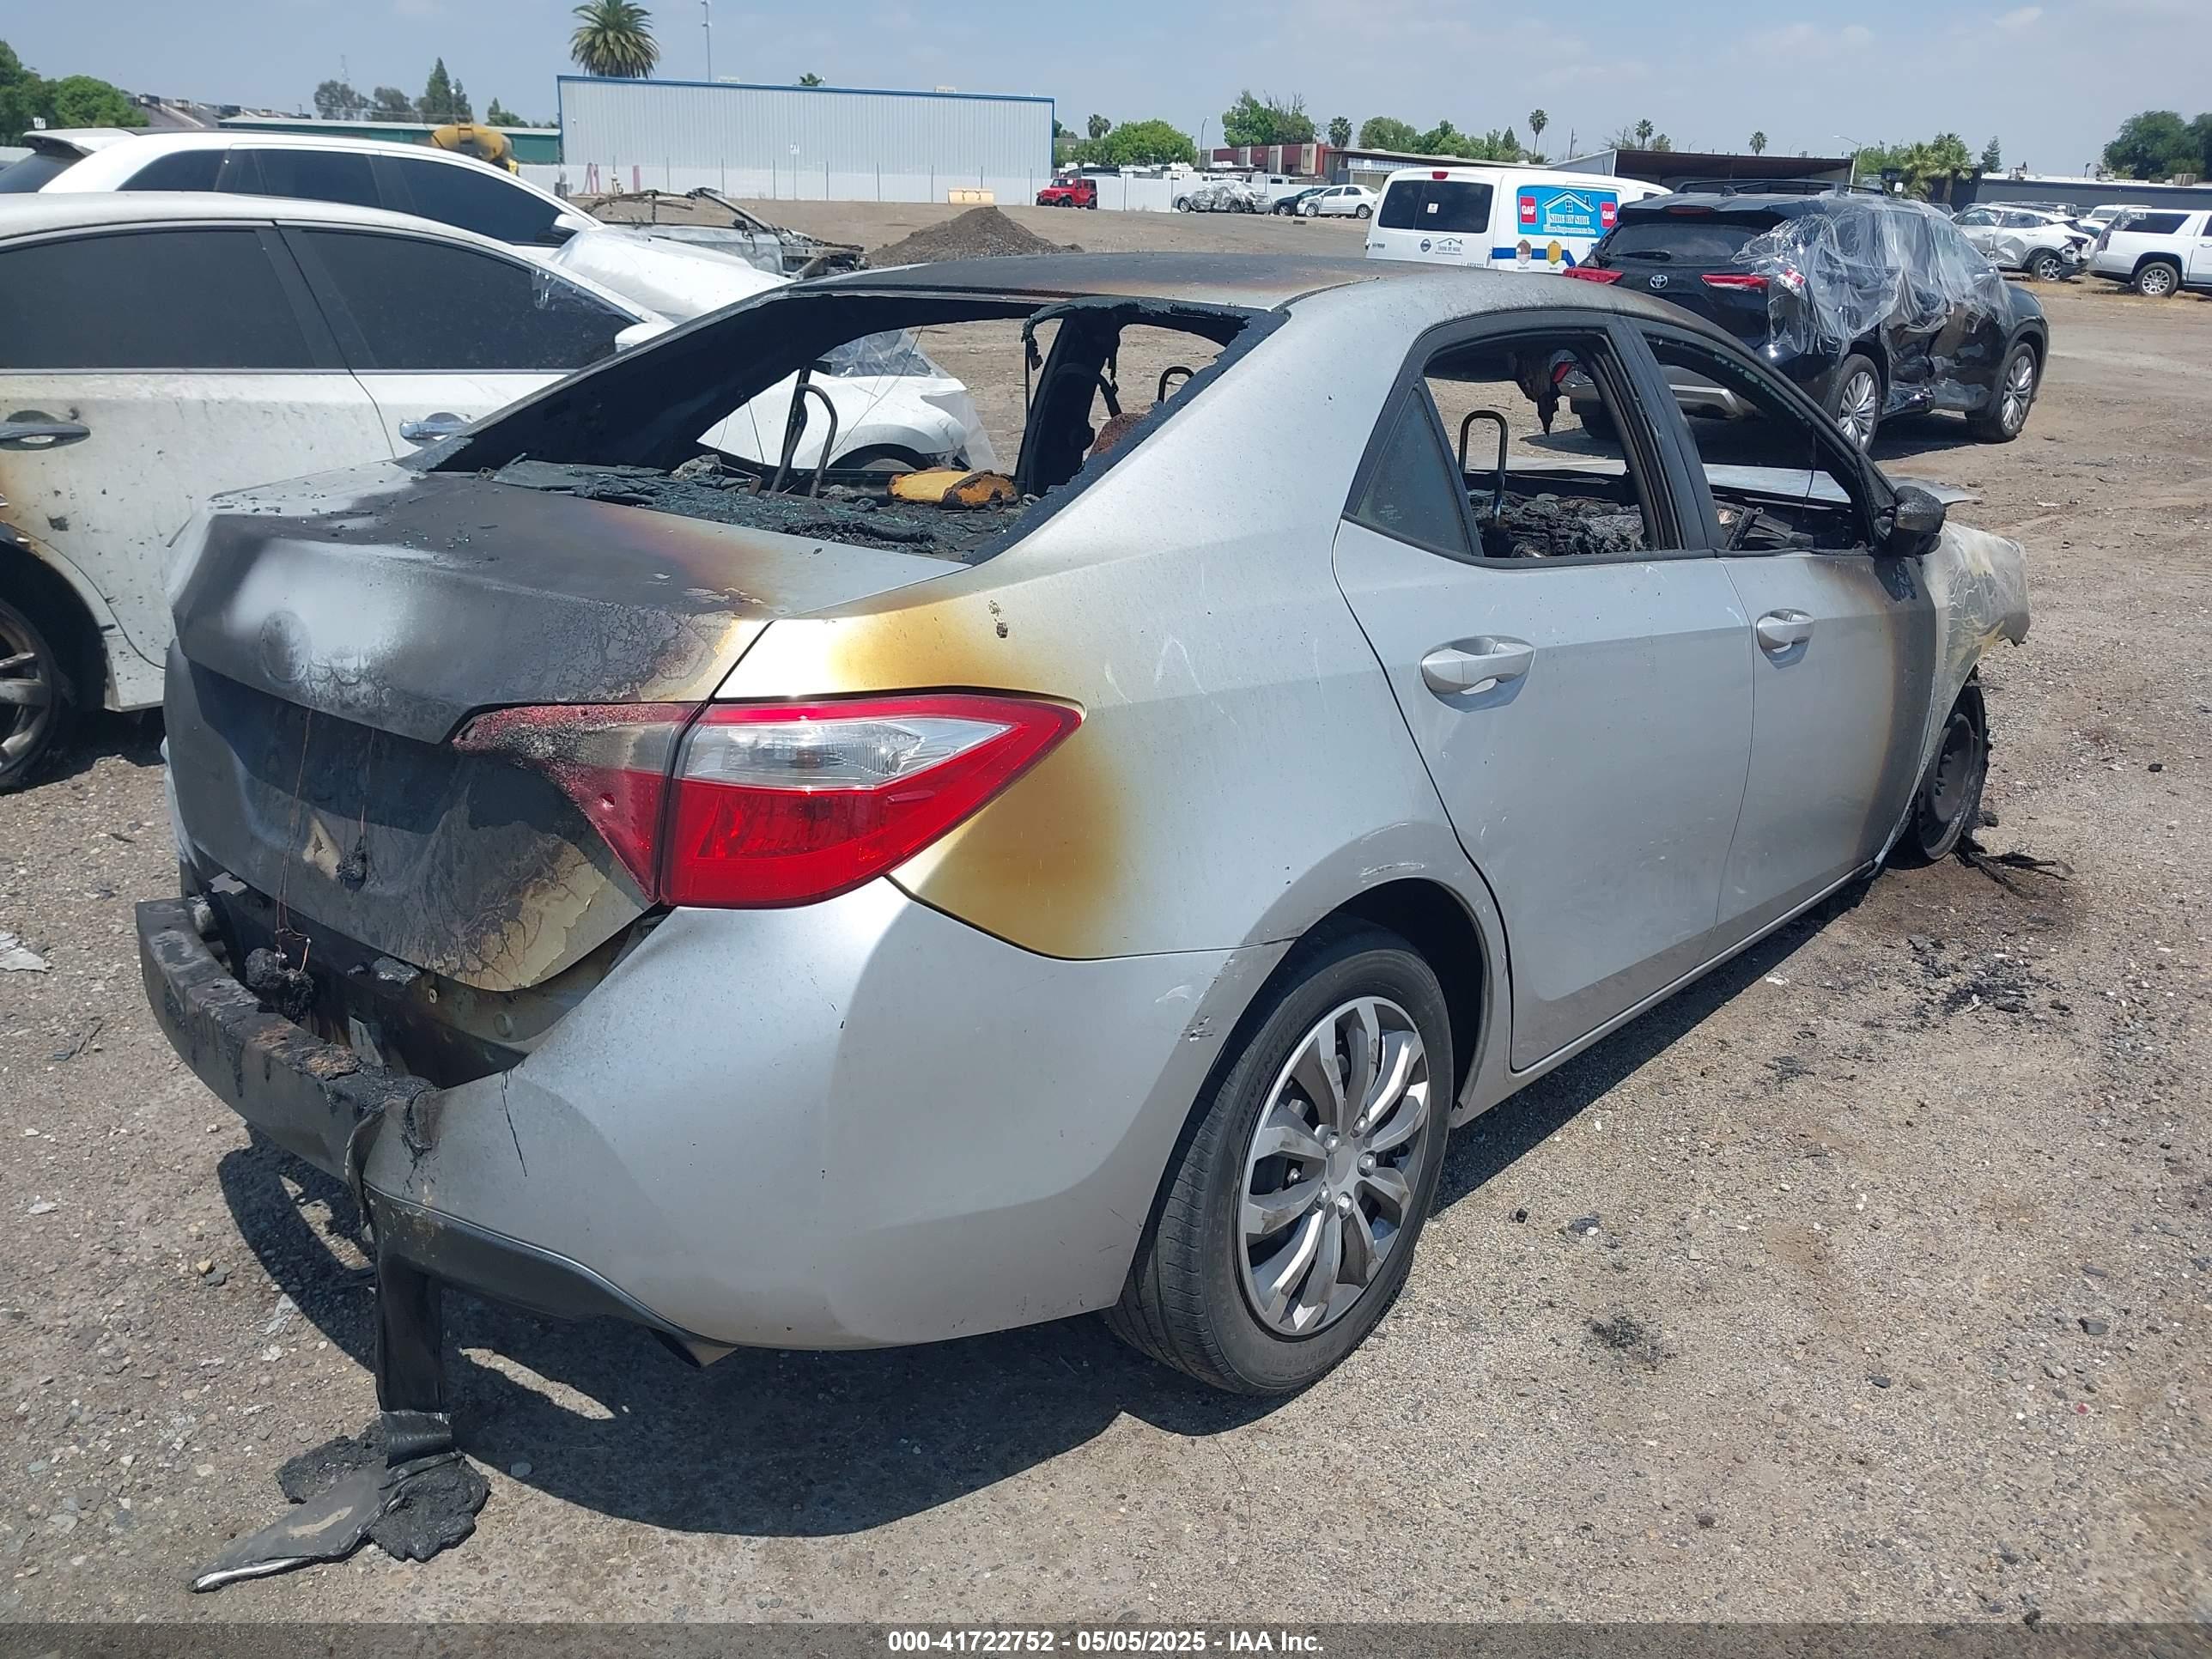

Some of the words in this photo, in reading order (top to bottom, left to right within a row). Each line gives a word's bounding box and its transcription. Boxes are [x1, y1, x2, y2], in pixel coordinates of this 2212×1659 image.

[1521, 204, 1535, 216] GAF
[1602, 210, 1615, 220] GAF
[1549, 214, 1564, 223] SIDE
[1565, 215, 1574, 224] BY
[1574, 216, 1589, 225] SIDE
